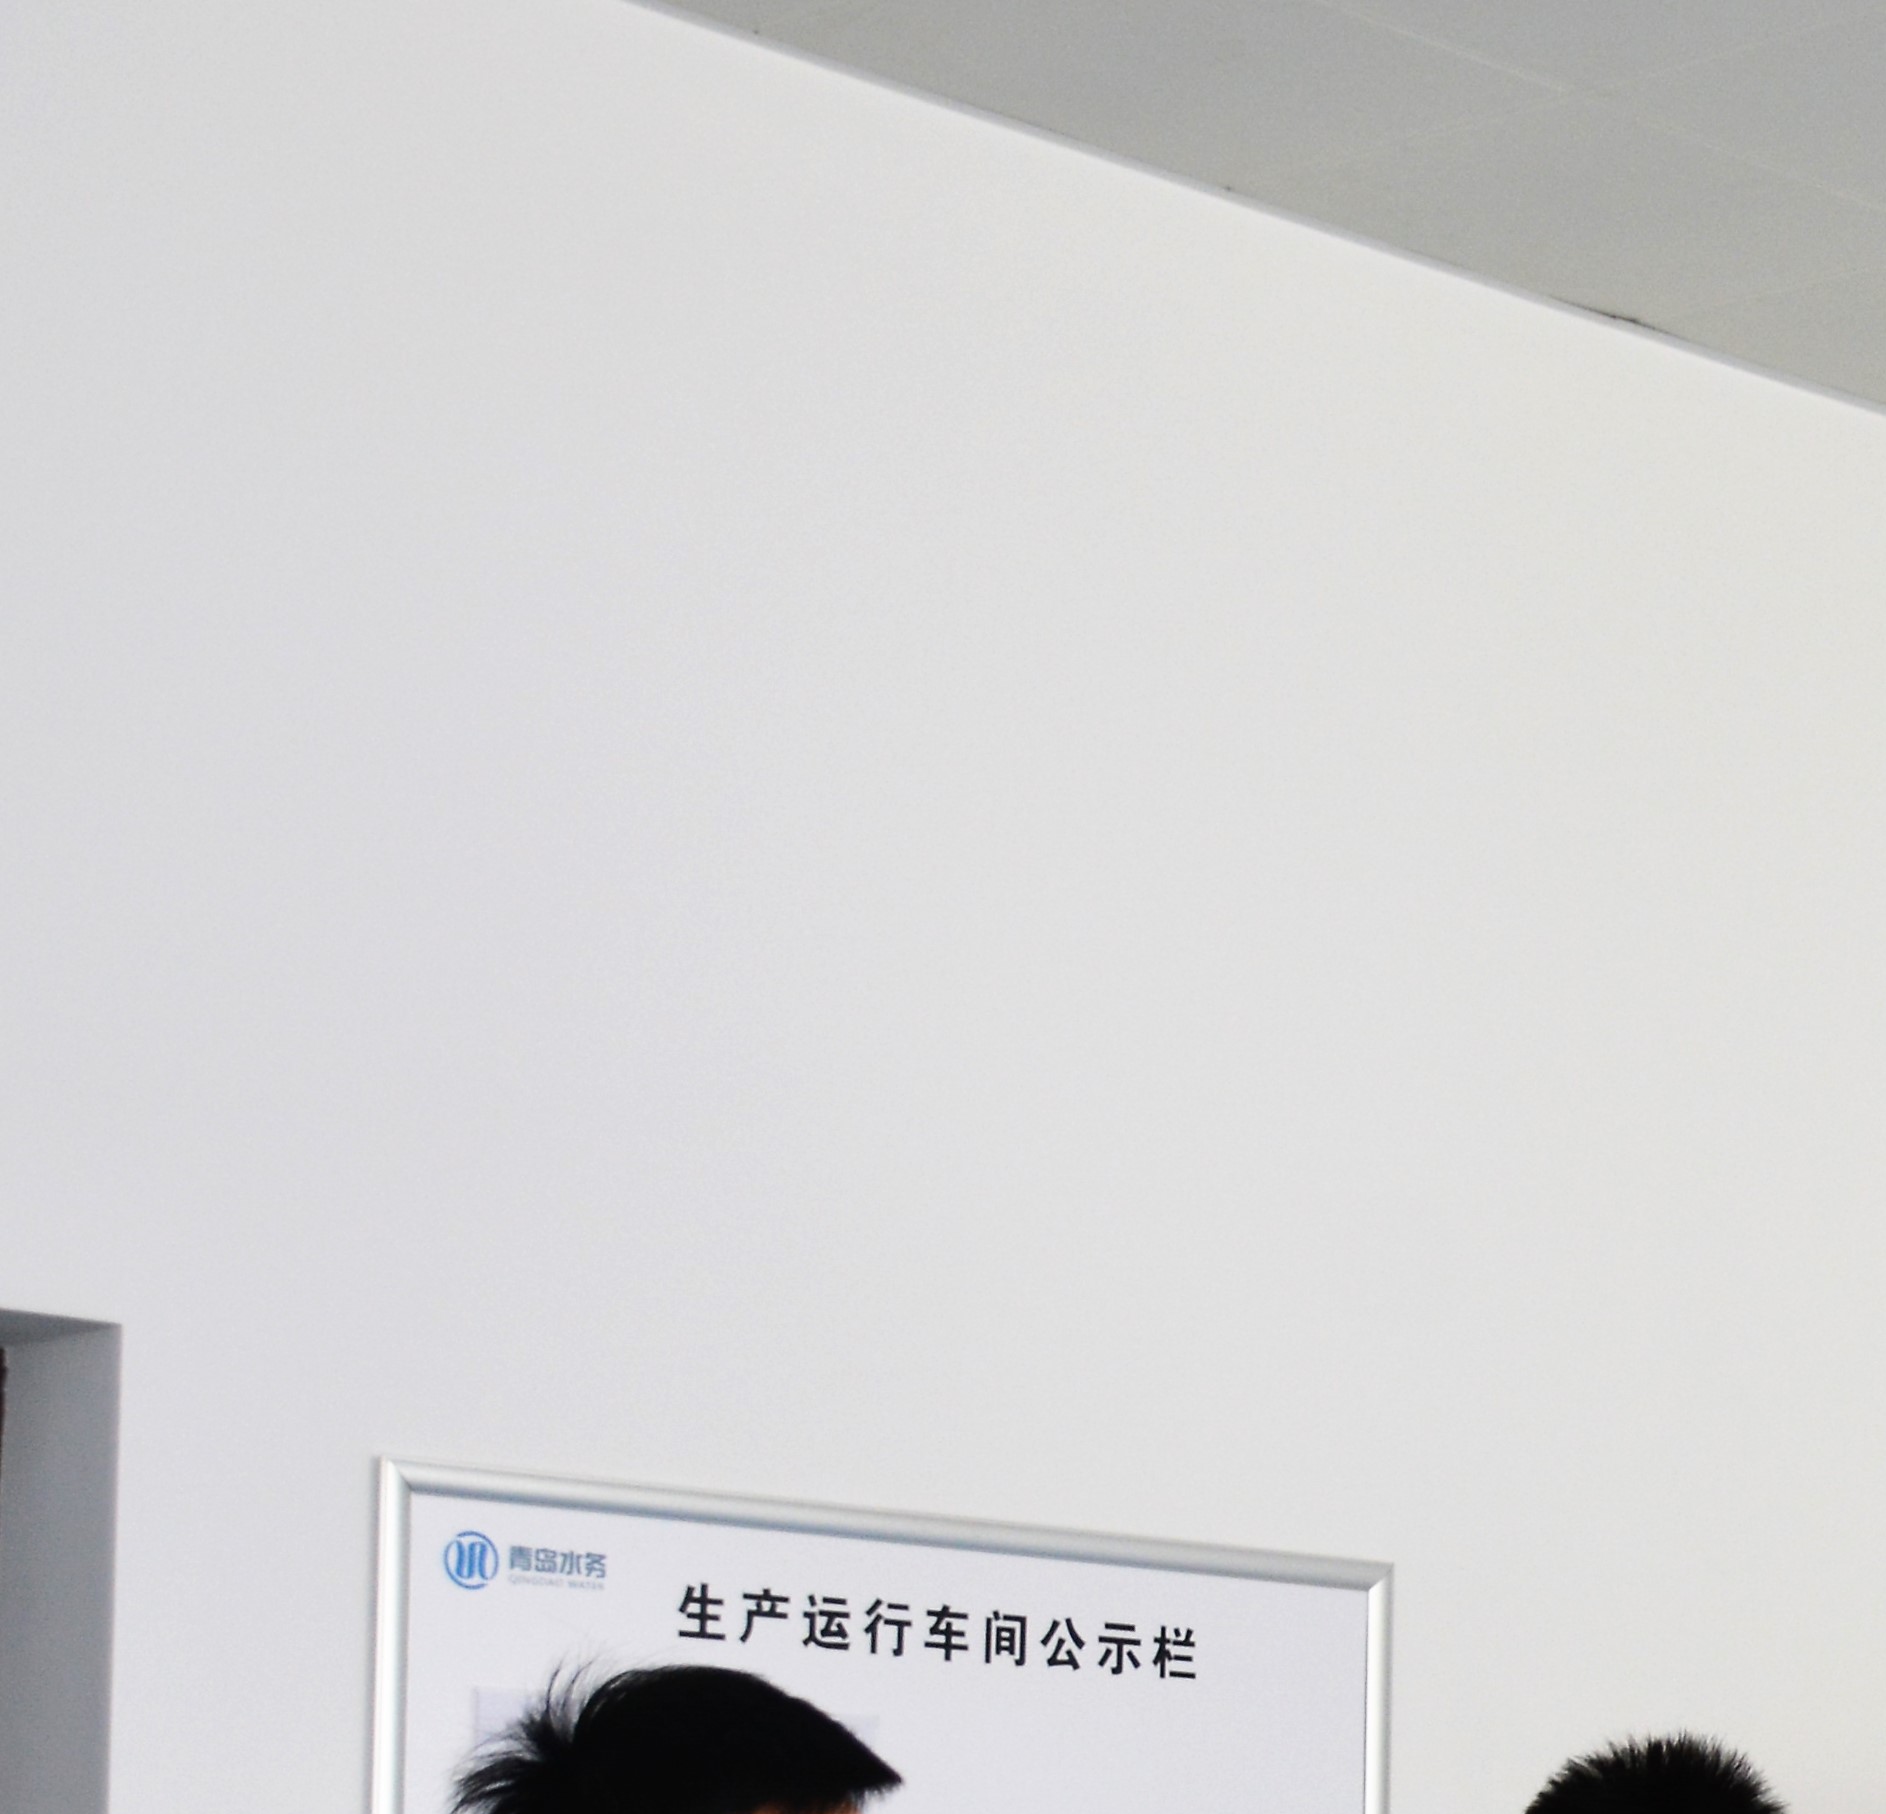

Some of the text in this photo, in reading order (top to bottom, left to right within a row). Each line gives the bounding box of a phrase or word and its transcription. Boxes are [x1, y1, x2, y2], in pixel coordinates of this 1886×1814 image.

[508, 1545, 607, 1579] 青岛水务
[677, 1583, 1198, 1680] 生产运行车间公示栏
